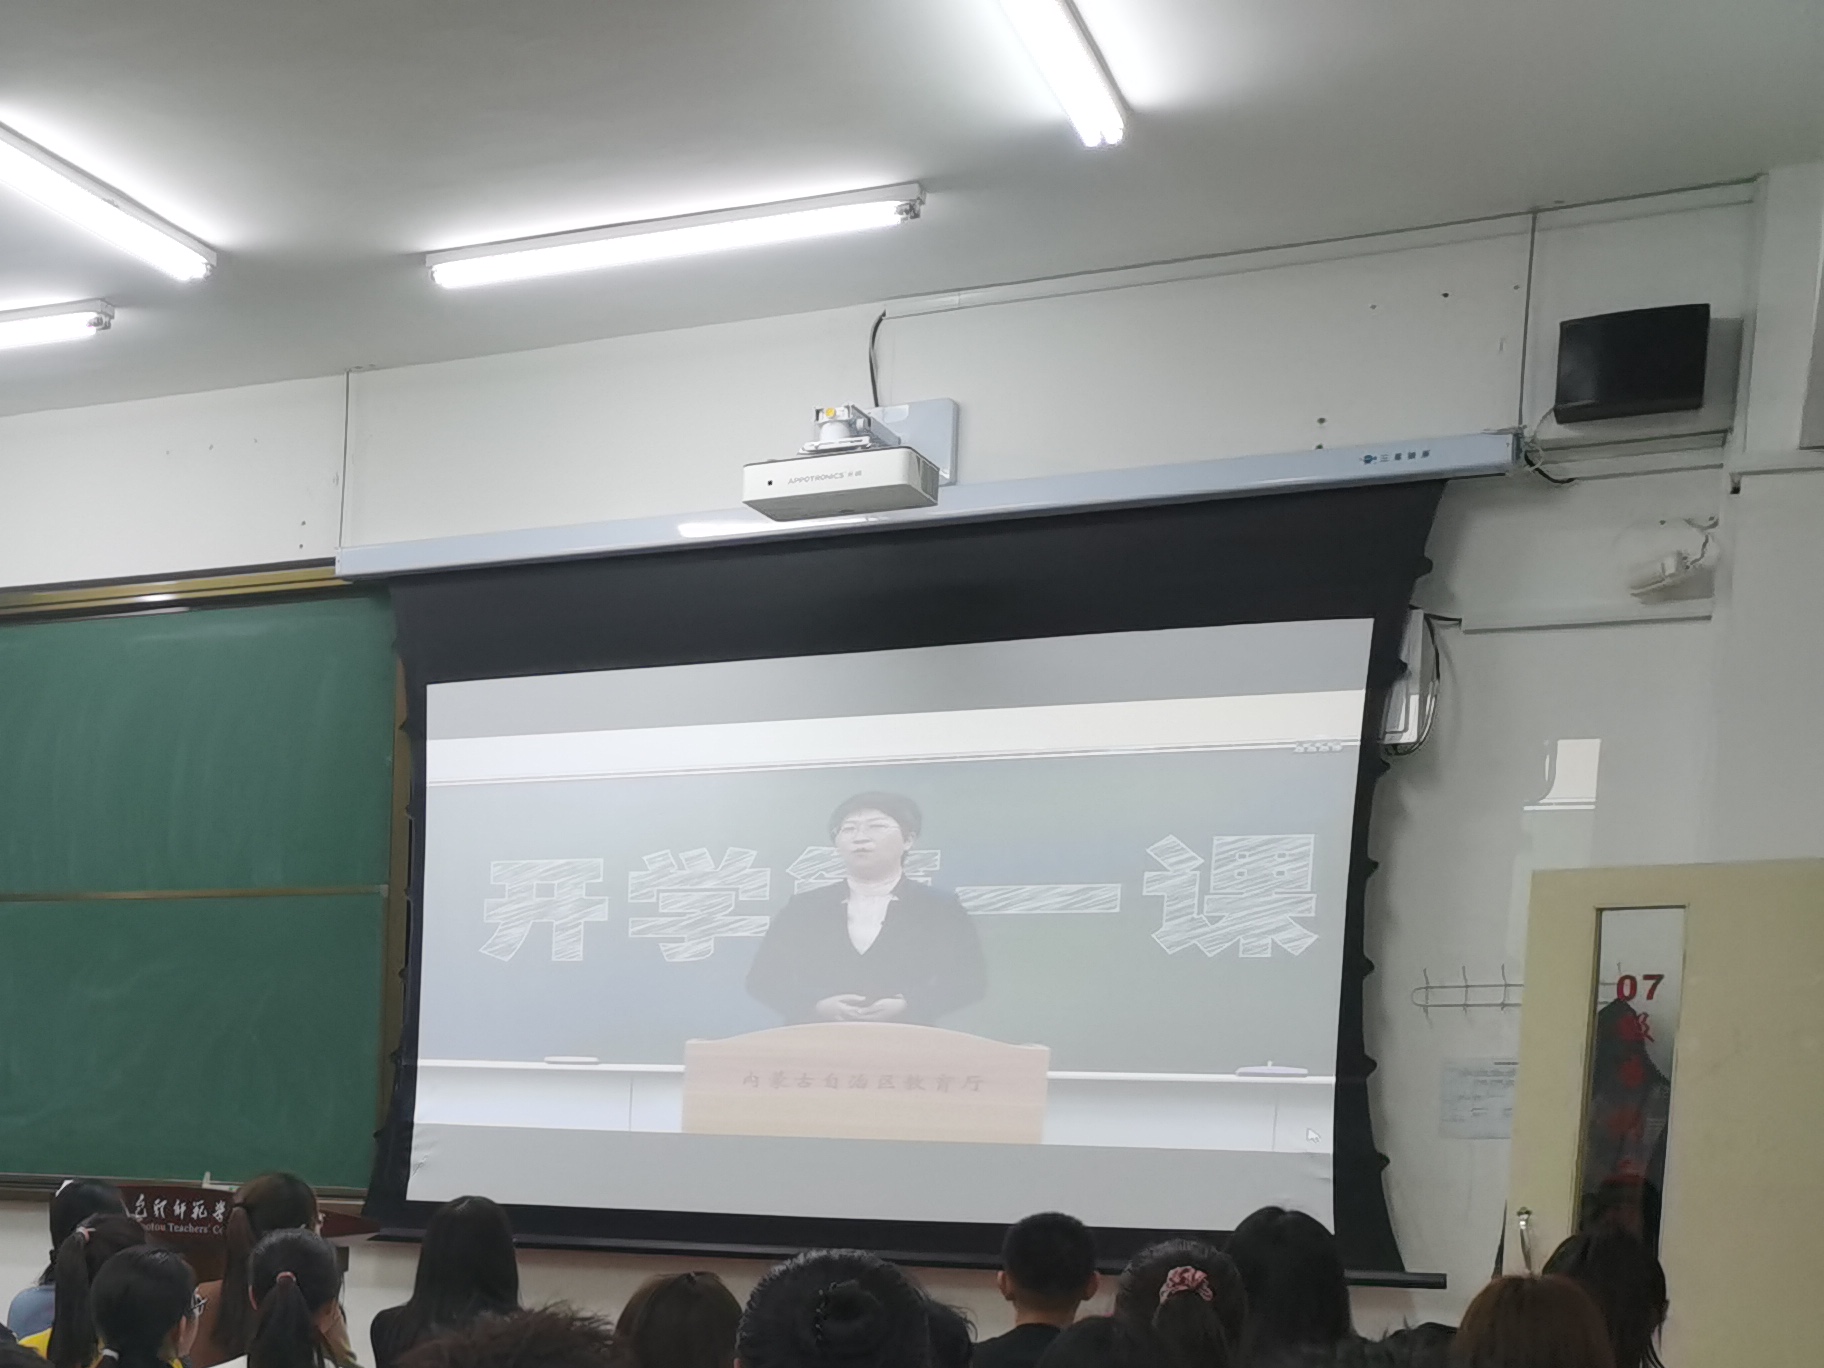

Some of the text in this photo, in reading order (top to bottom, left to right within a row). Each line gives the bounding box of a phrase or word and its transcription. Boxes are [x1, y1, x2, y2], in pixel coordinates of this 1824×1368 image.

[479, 833, 1318, 963] 开学一课
[742, 1071, 984, 1093] 内蒙古自治区教育厅
